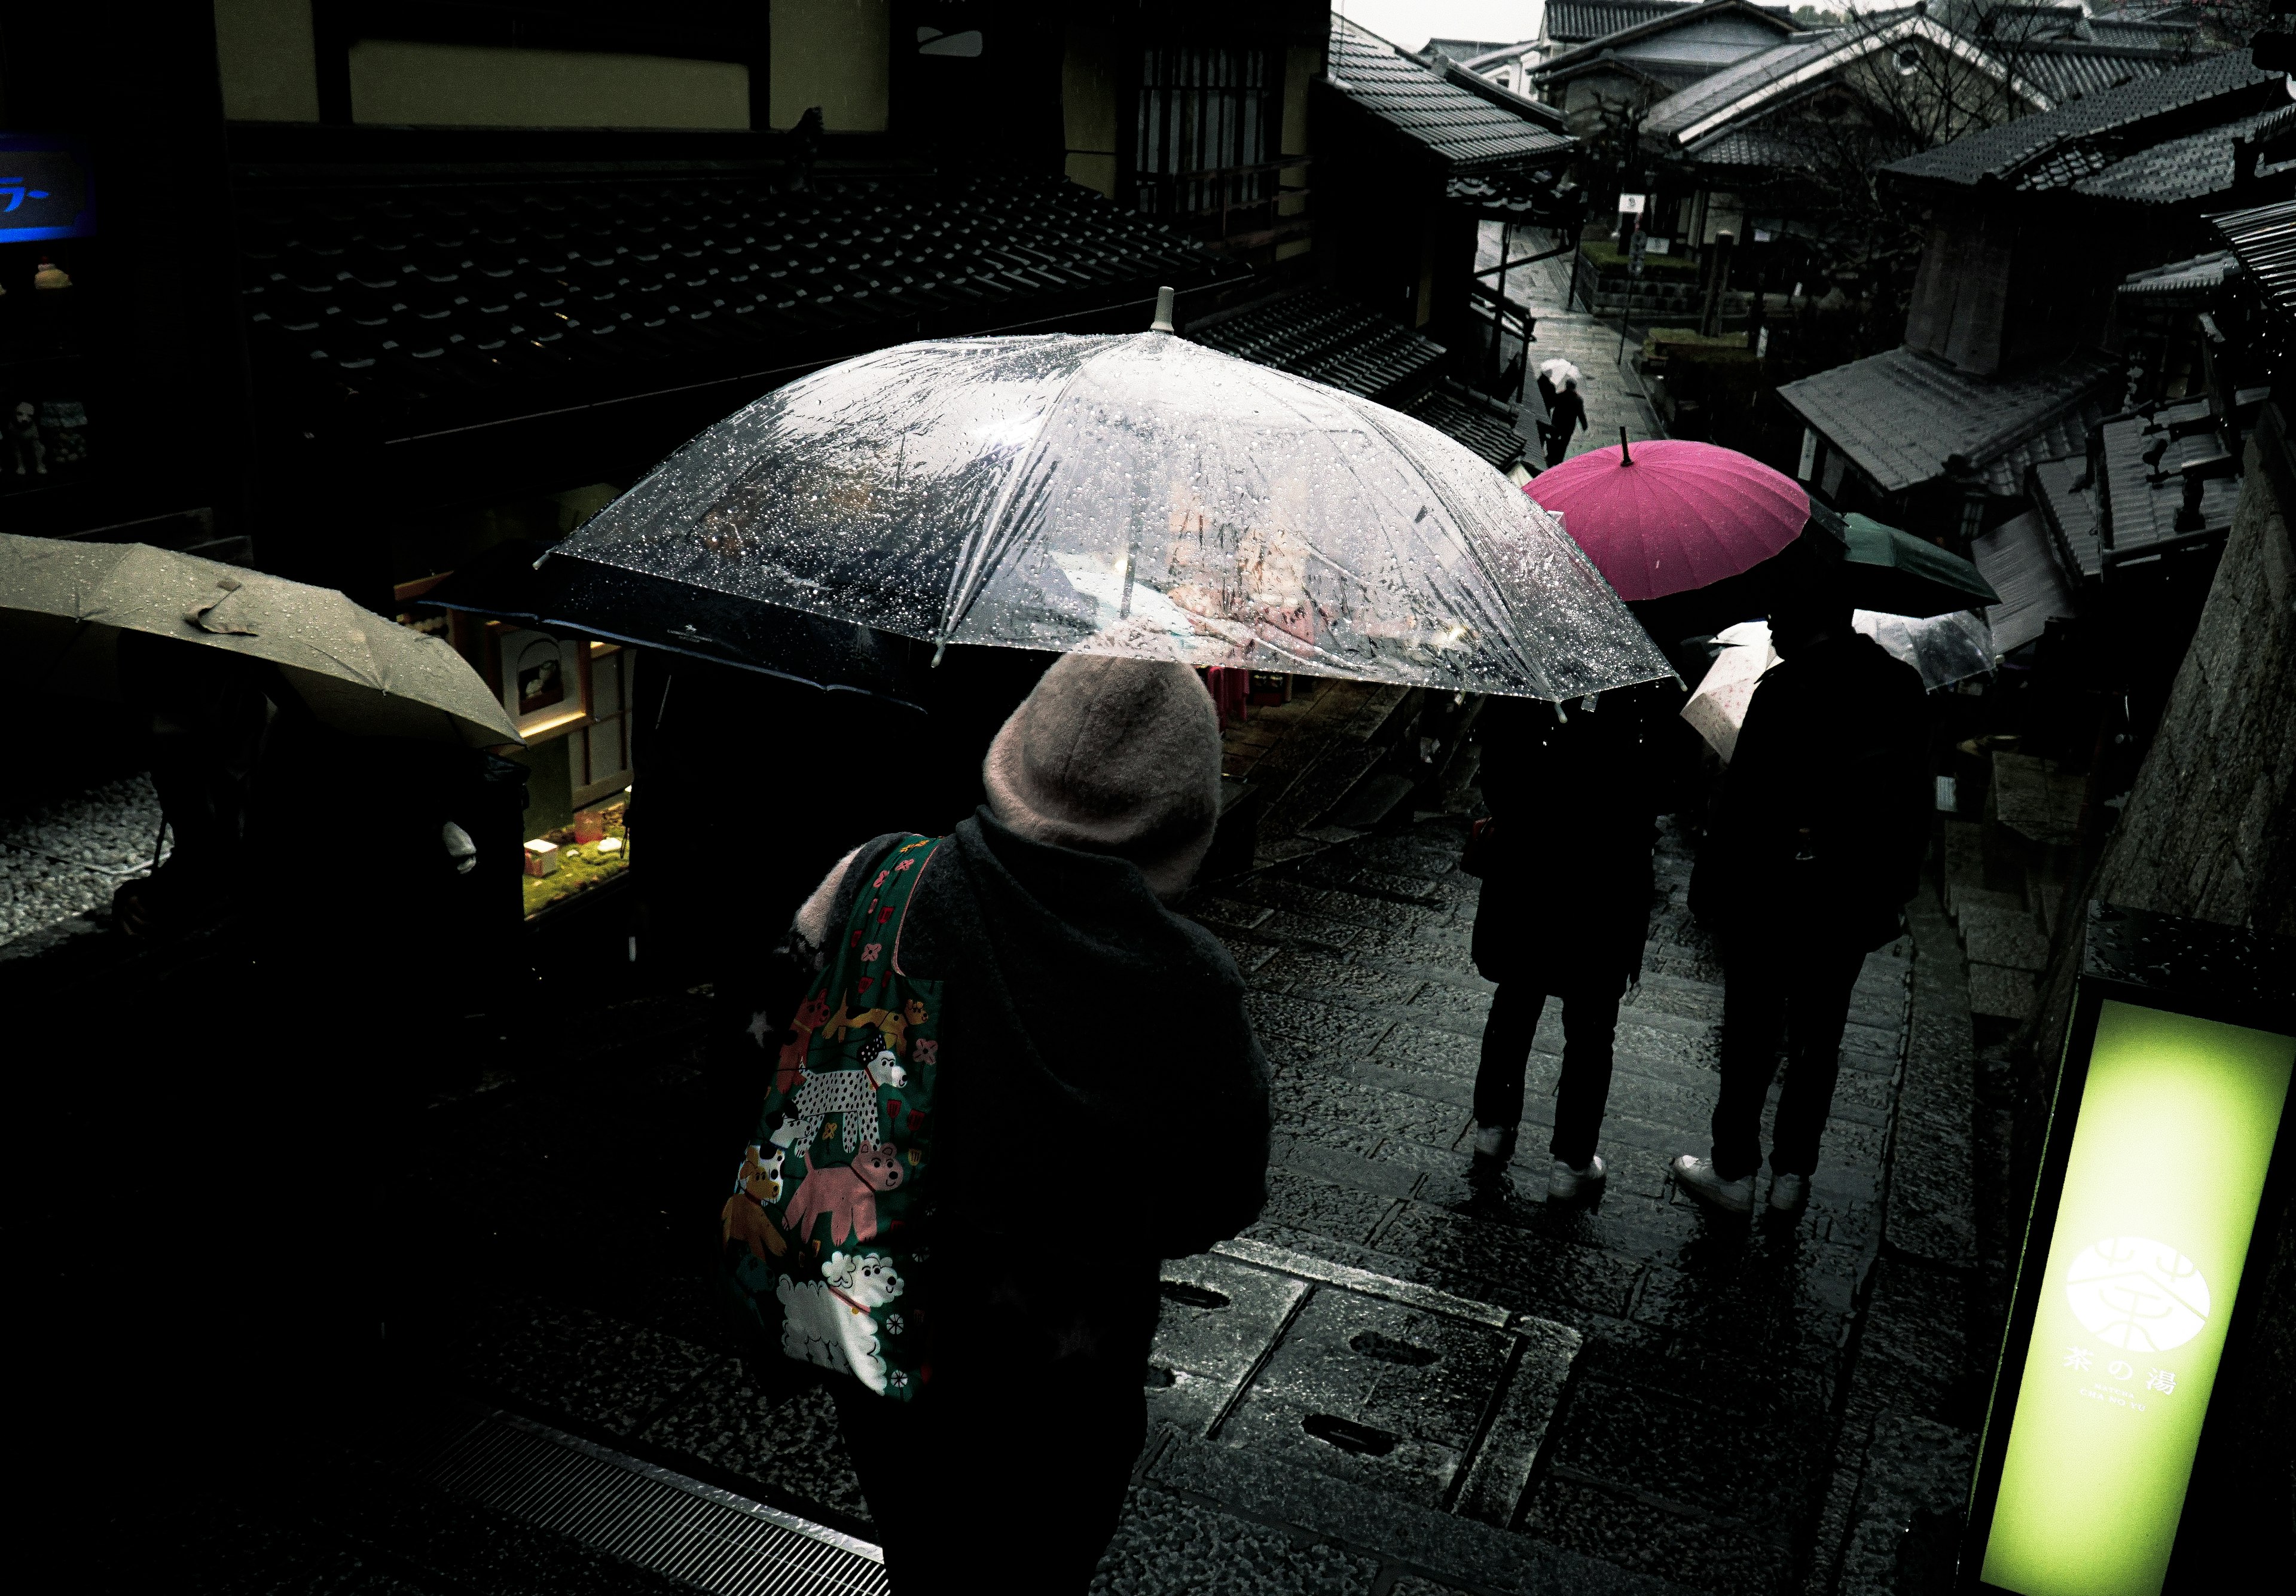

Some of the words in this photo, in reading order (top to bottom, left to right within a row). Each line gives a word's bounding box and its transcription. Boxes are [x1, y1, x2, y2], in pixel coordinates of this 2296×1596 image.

[2063, 1346, 2178, 1396] 茶の湯
[2079, 1388, 2103, 1401] CHA
[2108, 1396, 2126, 1407] NO
[2129, 1401, 2147, 1412] YU
[2095, 1383, 2134, 1399] MATCHA
